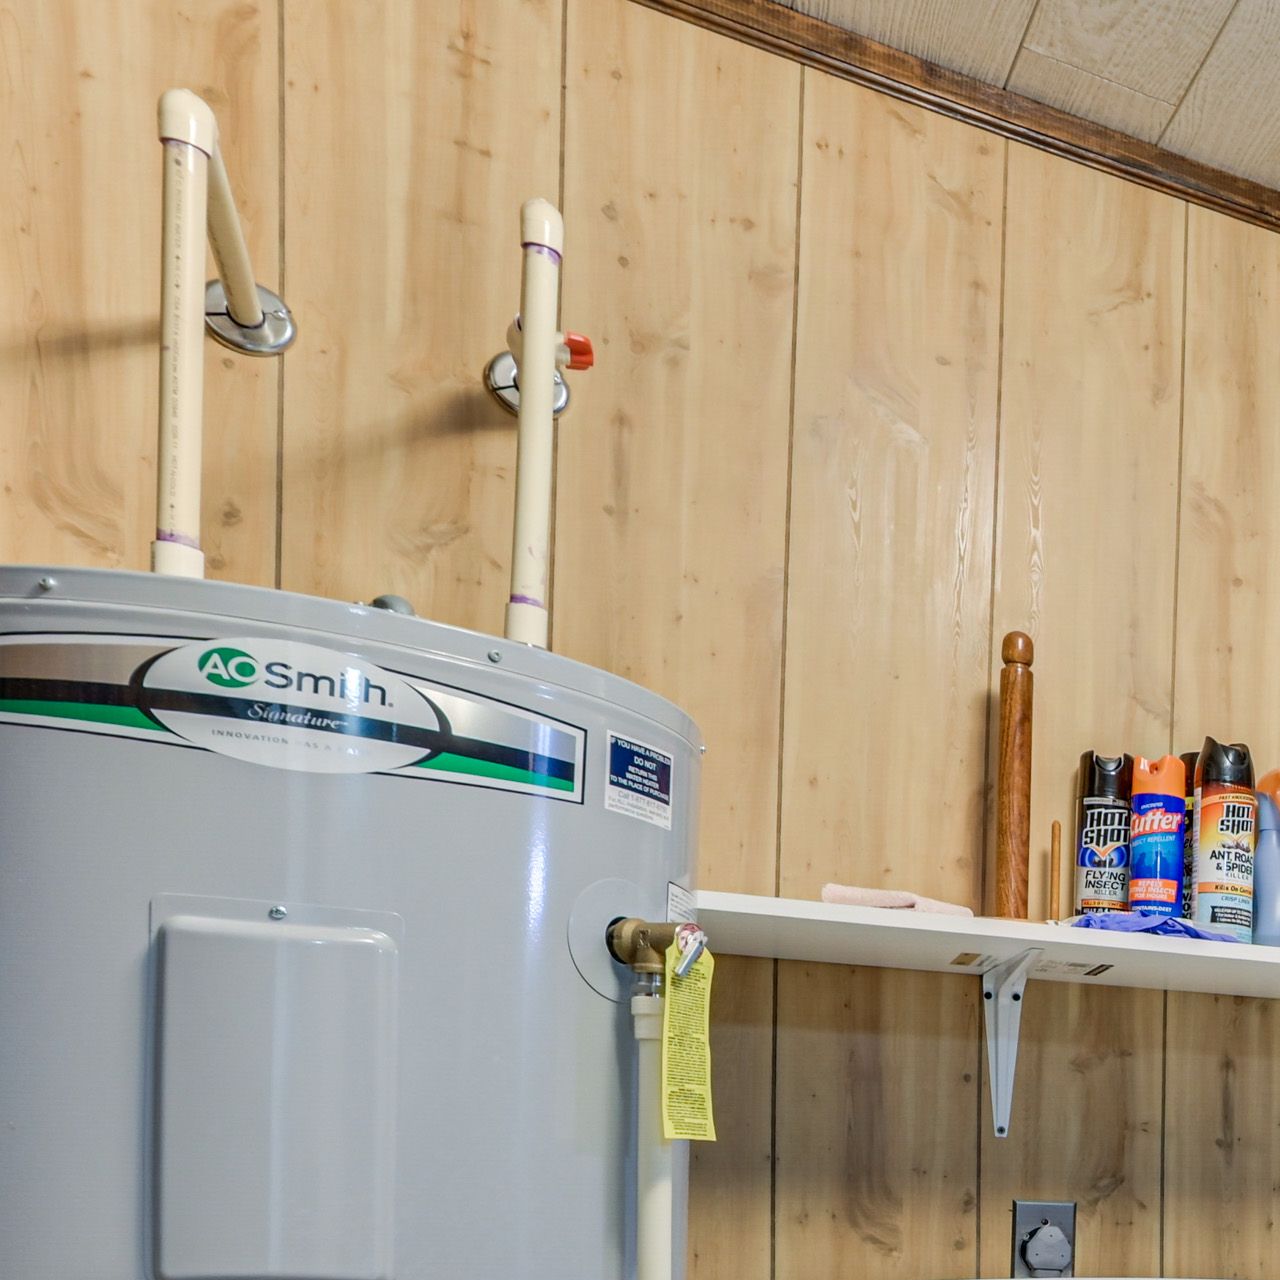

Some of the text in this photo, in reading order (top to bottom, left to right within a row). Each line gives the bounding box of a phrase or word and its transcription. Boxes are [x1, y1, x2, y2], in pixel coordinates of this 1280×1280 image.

[264, 662, 394, 708] Smih
[247, 703, 341, 729] Signature
[633, 756, 657, 771] DO NOT
[1086, 808, 1128, 829] HOT
[1224, 804, 1253, 819] HOT
[1218, 818, 1254, 835] SHOT
[1082, 826, 1130, 848] SHOT
[1215, 863, 1223, 871] &
[1085, 870, 1126, 881] FLYING
[1084, 880, 1127, 891] INSECT
